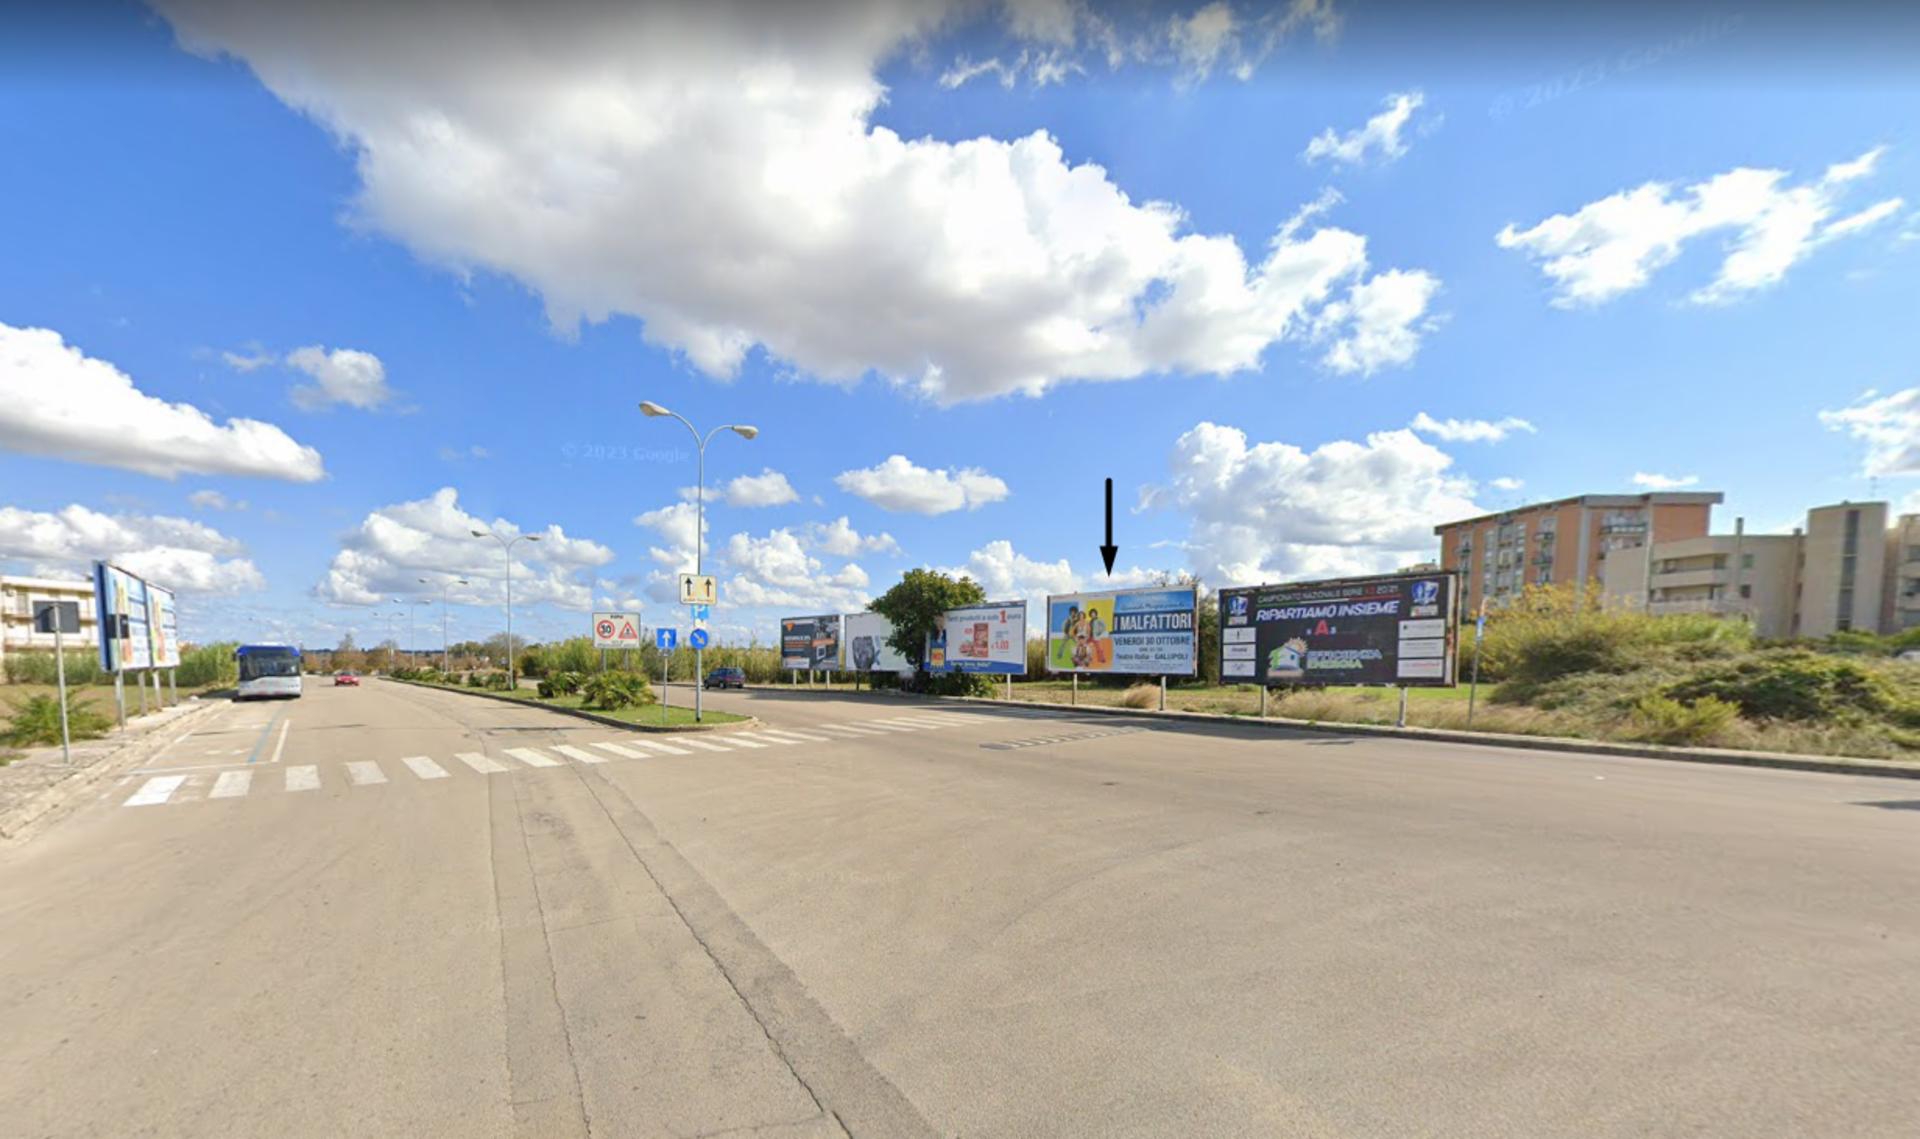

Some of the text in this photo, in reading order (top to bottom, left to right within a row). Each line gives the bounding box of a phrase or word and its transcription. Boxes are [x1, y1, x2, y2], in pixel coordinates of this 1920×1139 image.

[1256, 605, 1337, 620] RIPARTIAMO
[1338, 601, 1399, 616] INSIEME
[1121, 613, 1192, 630] MALFATTORI
